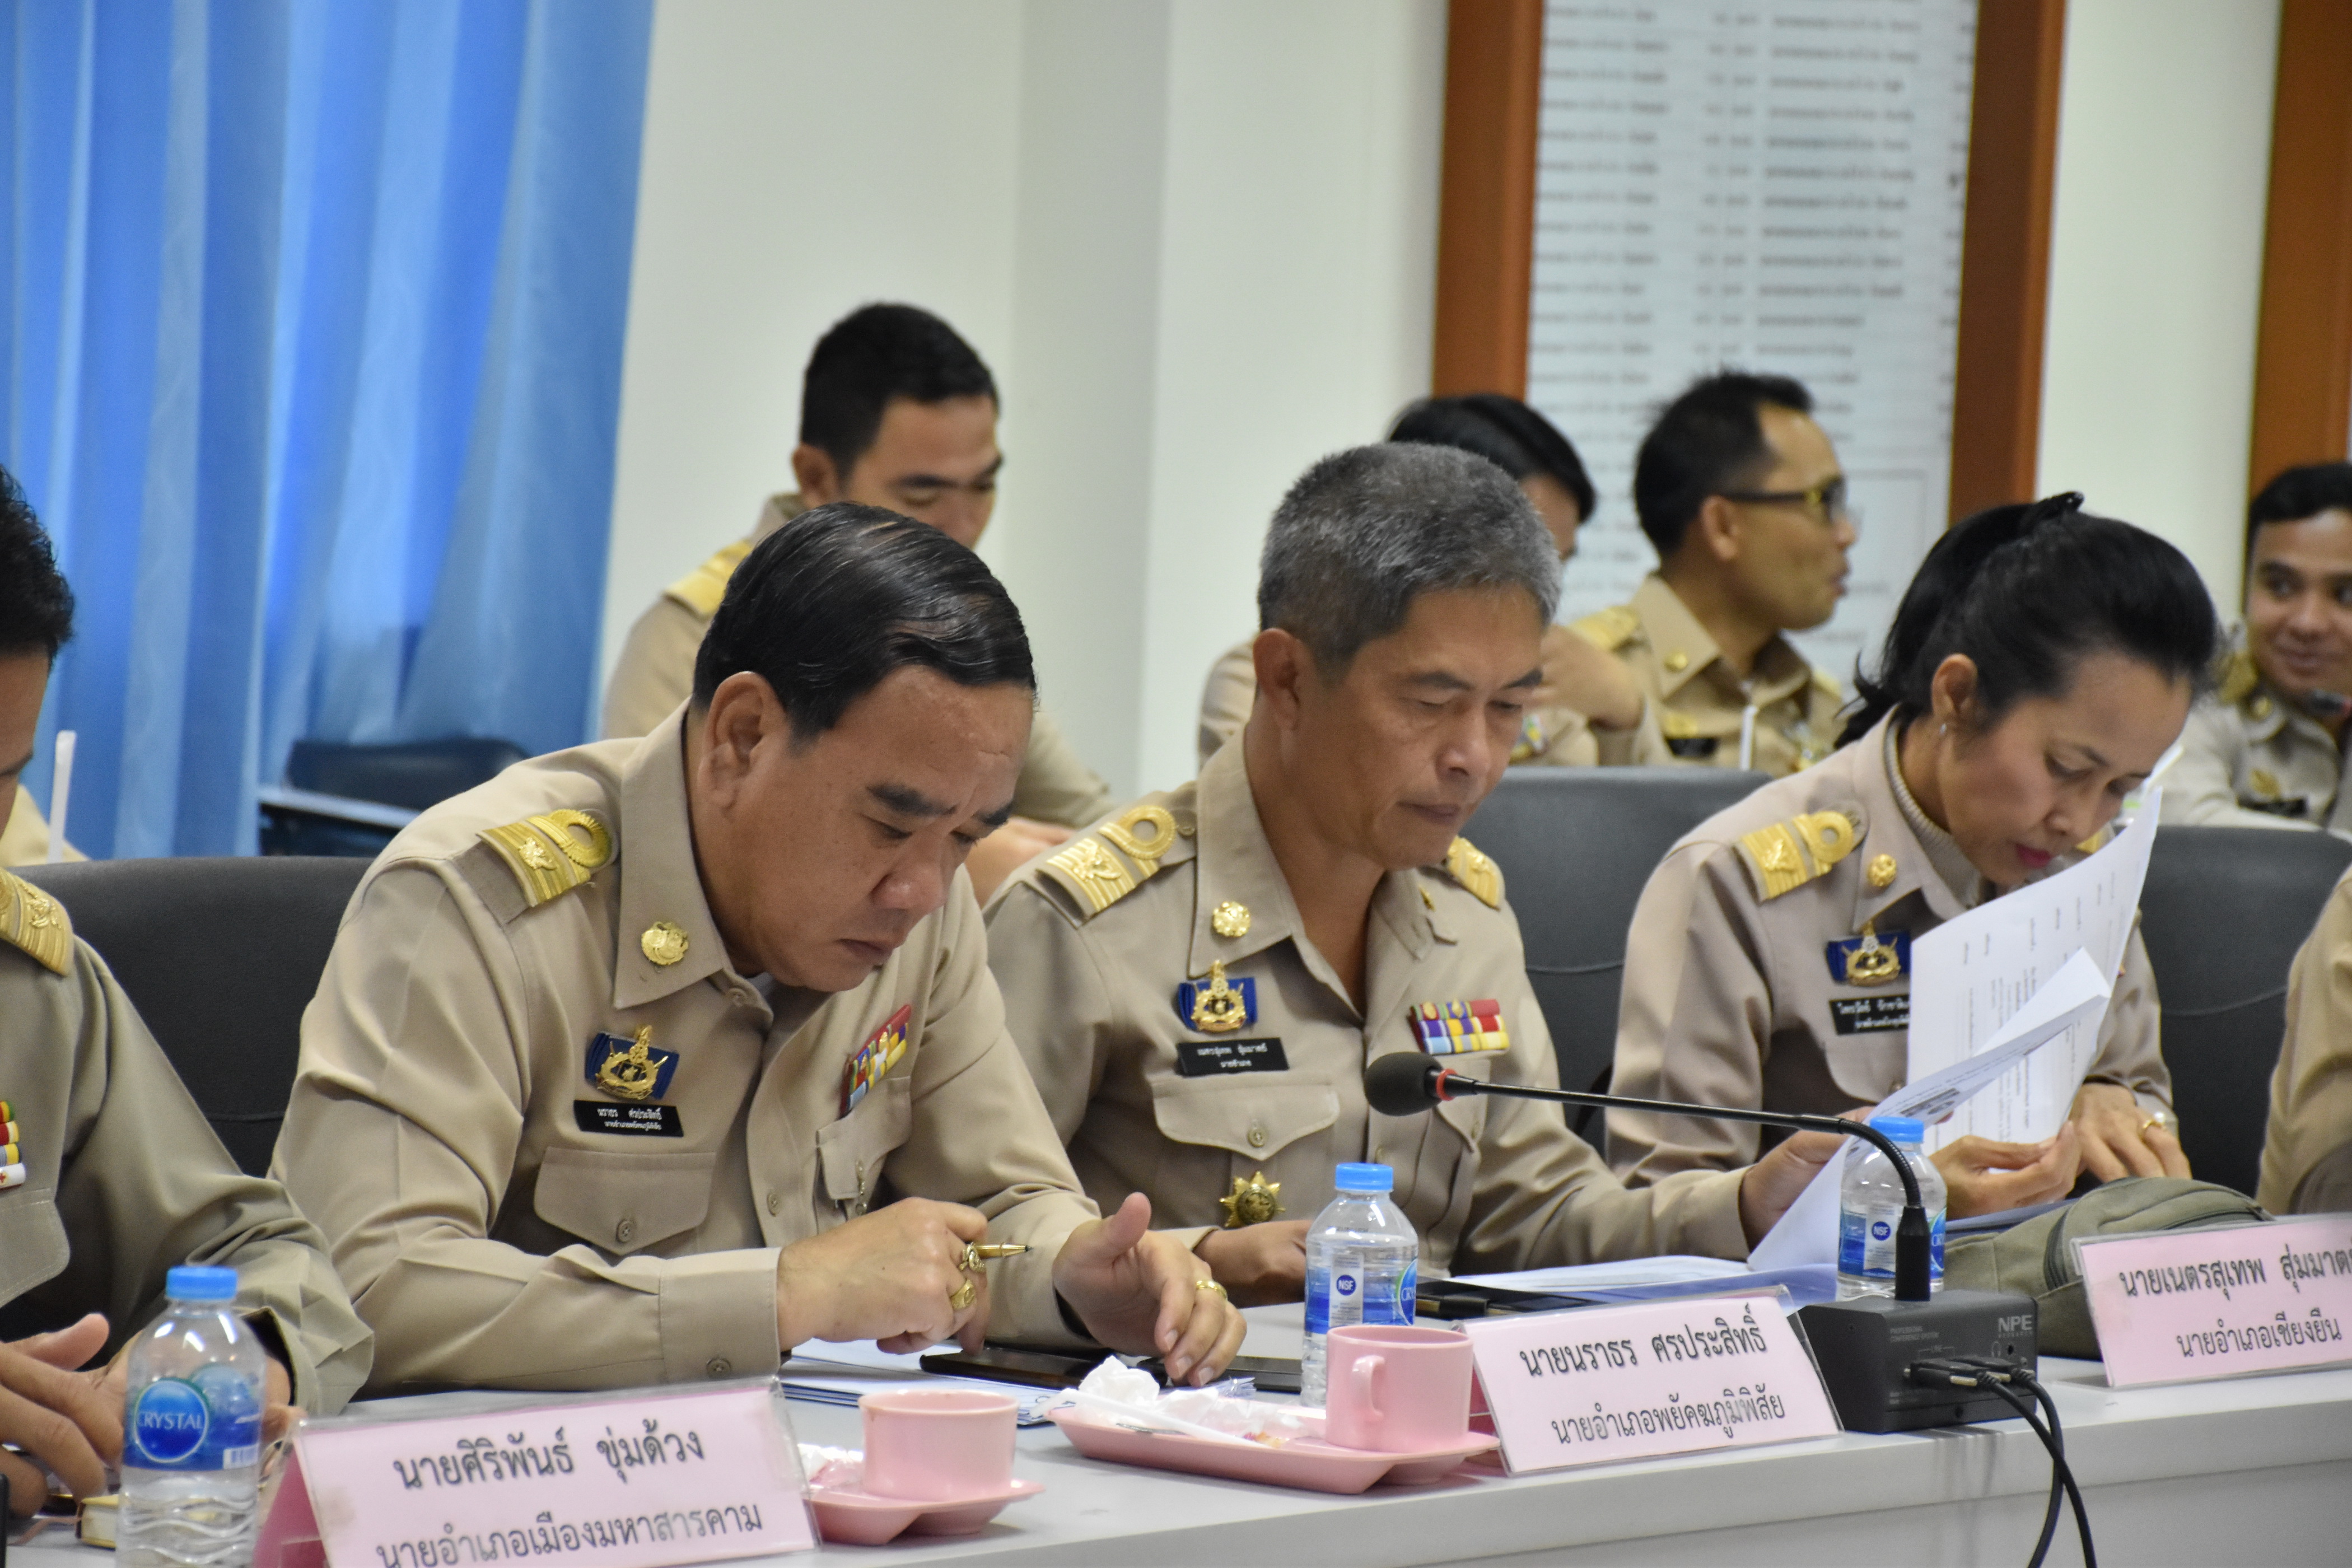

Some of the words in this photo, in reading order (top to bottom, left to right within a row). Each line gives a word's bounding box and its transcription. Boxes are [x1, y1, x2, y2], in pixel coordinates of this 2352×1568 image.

[1337, 1280, 1354, 1291] NSF
[2119, 1258, 2266, 1301] นายเนตรสุเทพ
[2279, 1238, 2352, 1293] สุ่มมาต
[1519, 1339, 1638, 1378] นายนราธร
[1651, 1303, 1768, 1363] ศรประสิทธิ์
[1998, 1315, 2033, 1333] NPE
[2176, 1307, 2342, 1357] นายอำเภอเชียงยืน
[138, 1410, 203, 1430] CRYSTAL
[1551, 1383, 1785, 1444] นายอำเภอพยัคฆภูมิพิสัย
[393, 1426, 575, 1490] นายศิริพันธ์
[596, 1418, 705, 1483] ขุ่มด้วง
[376, 1504, 763, 1568] นายอำเภอเมืองมหาสารคาม
